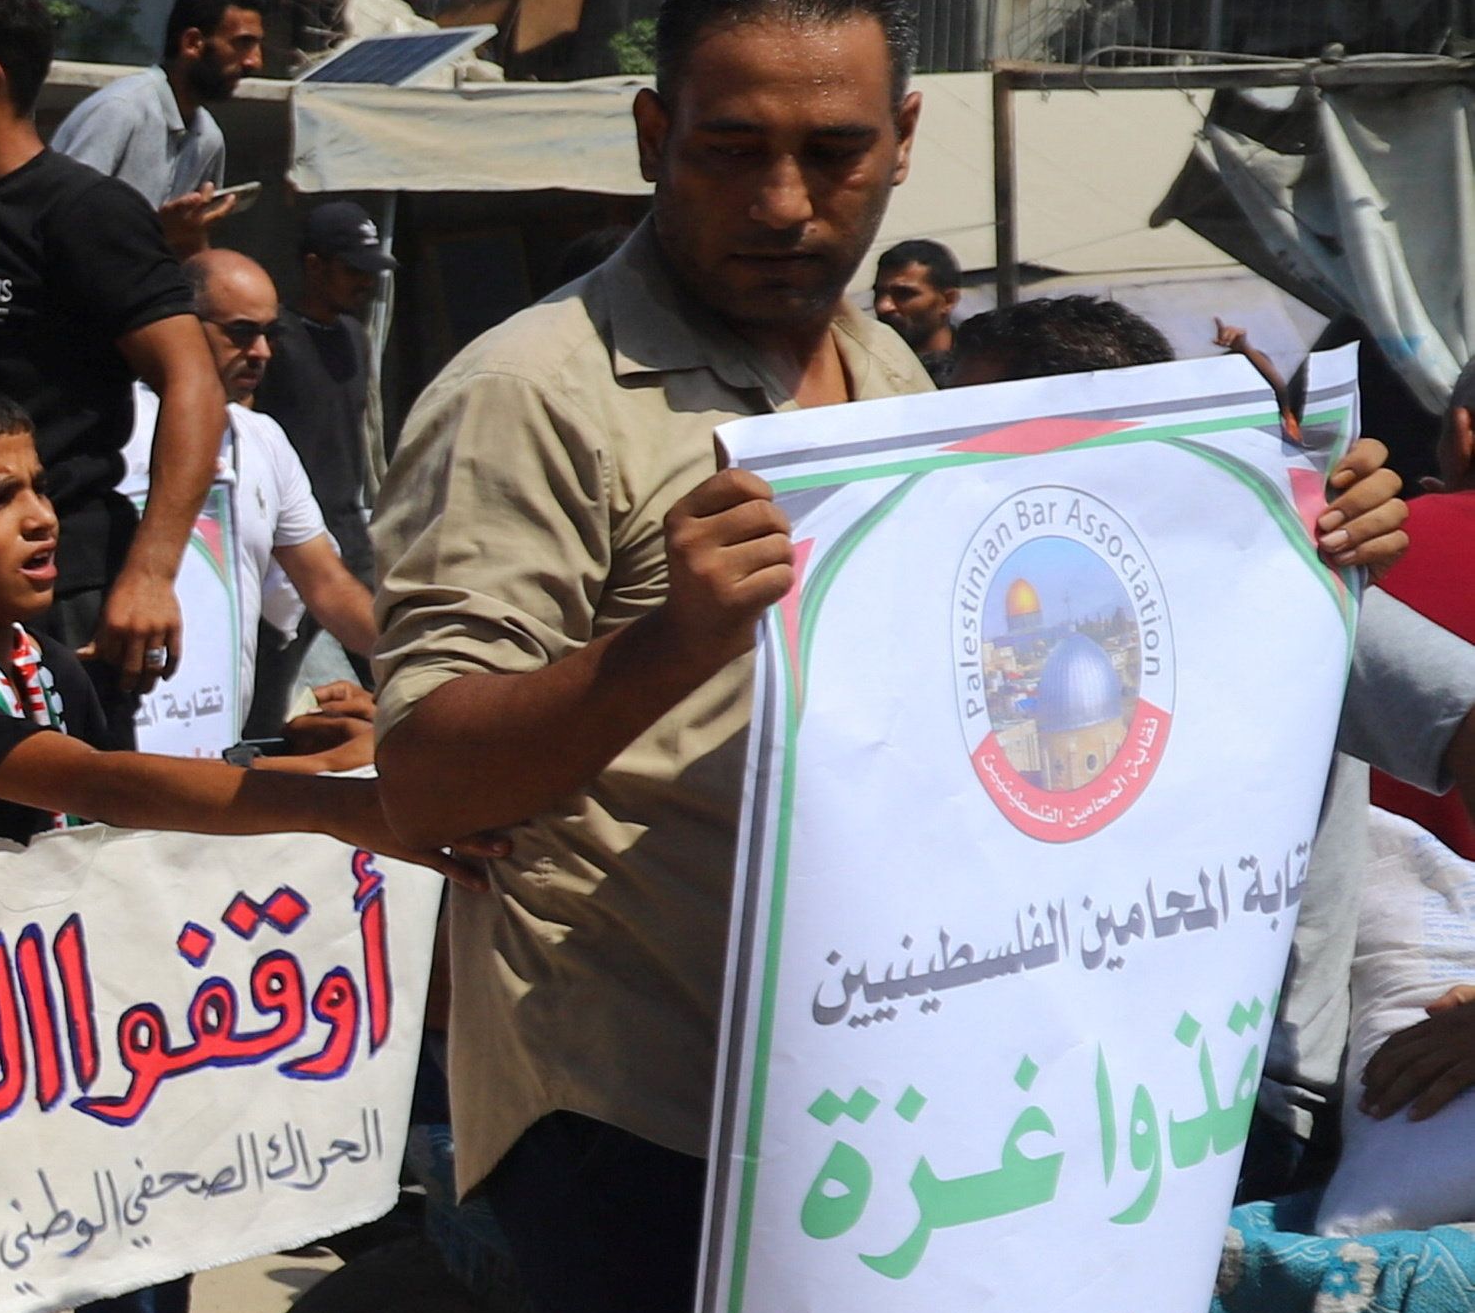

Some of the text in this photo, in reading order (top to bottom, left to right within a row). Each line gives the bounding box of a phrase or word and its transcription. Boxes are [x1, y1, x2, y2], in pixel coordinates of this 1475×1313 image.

[958, 498, 1162, 719] Palestinian Bar Association
[162, 685, 225, 727] نقابة
[1124, 715, 1160, 780] نقابة
[1065, 772, 1128, 829] المحامين
[1080, 863, 1230, 971] المحامين
[1238, 839, 1310, 933] قابة
[57, 848, 394, 1126] أوقفوا
[811, 896, 1069, 1030] الفلسطينيين
[123, 1131, 264, 1249] الصحفي
[263, 1107, 384, 1191] الحراك
[799, 989, 1281, 1281] قذوا غزة
[0, 1168, 124, 1296] الوطني
